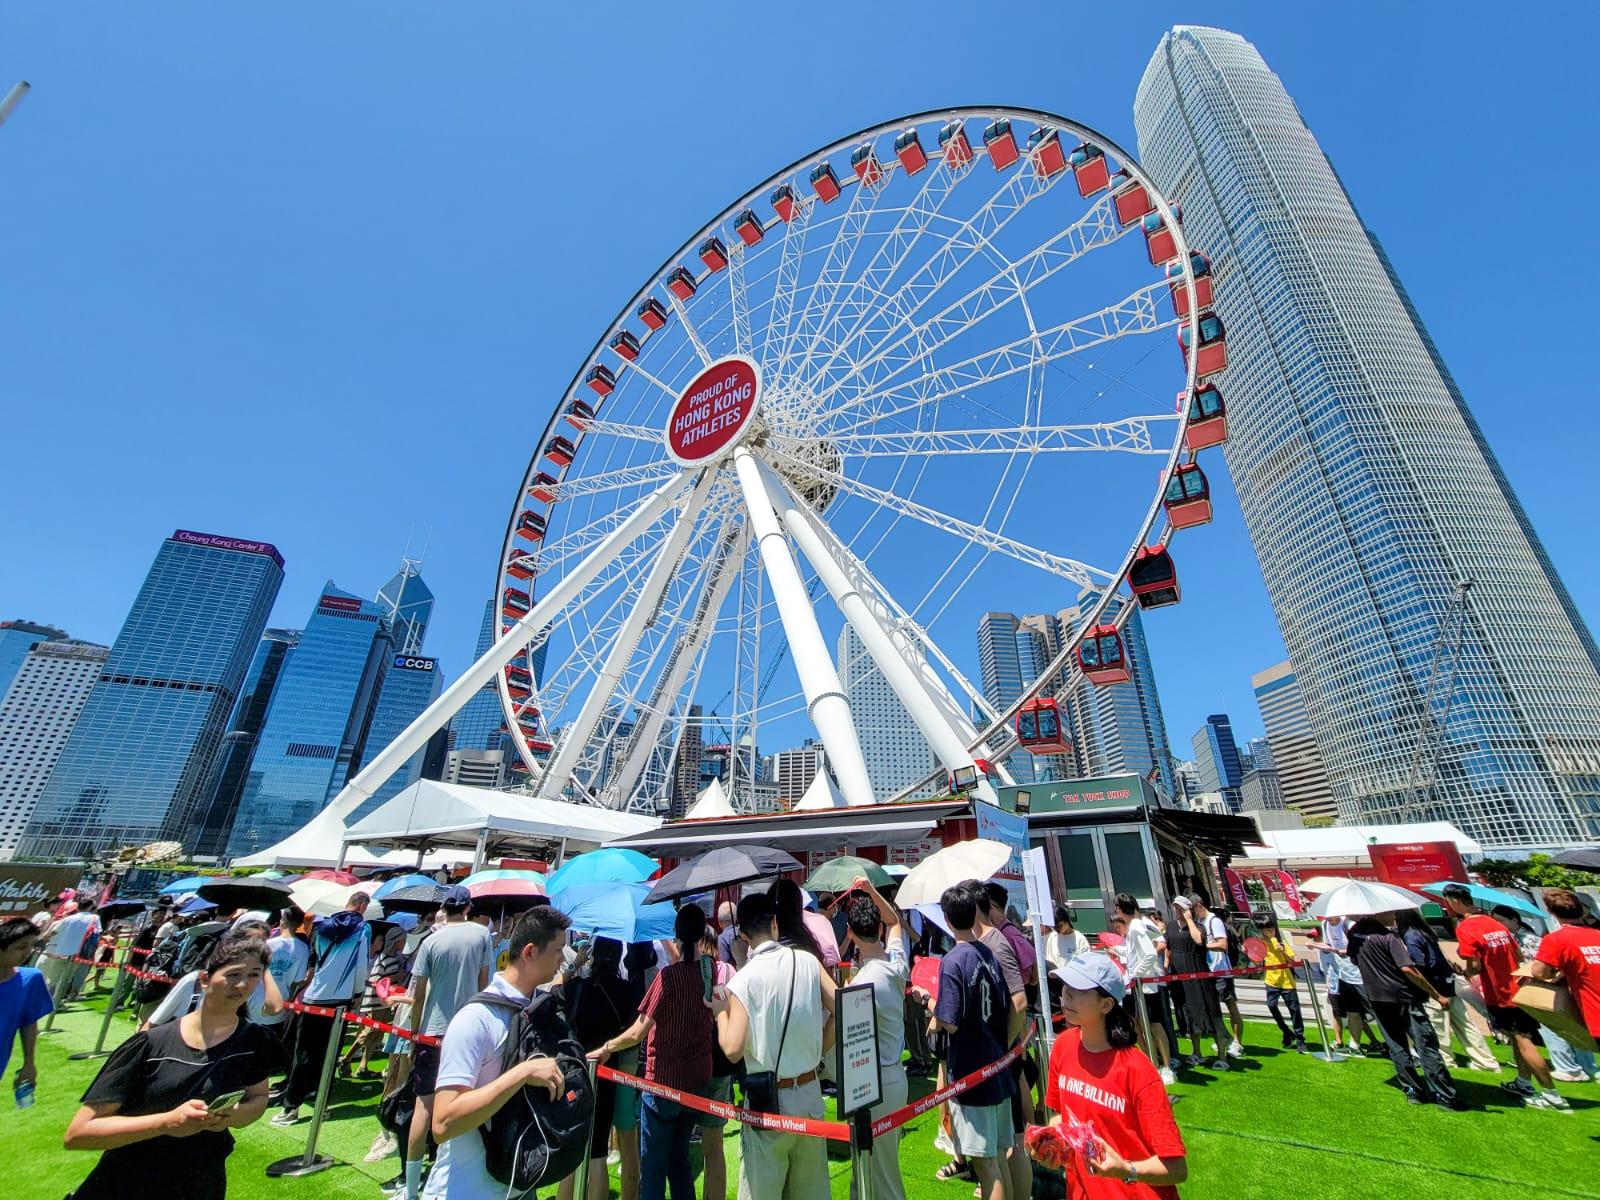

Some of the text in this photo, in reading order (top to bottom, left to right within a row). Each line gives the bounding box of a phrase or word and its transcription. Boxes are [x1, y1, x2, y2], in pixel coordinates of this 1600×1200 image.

[690, 373, 739, 408] PROUD OF
[675, 382, 751, 433] HONG KONG
[681, 406, 741, 448] ATHLETES
[179, 532, 210, 545] Cheung
[210, 537, 231, 547] Kong
[233, 541, 258, 551] Center
[405, 658, 434, 670] CCB
[0, 878, 50, 904] itality
[1232, 882, 1245, 902] AIA
[1285, 883, 1298, 901] AIA
[612, 1071, 625, 1083] Hong
[637, 1080, 665, 1096] Observation
[665, 1087, 681, 1101] Wheel
[710, 1102, 807, 1131] Hong Kong Observation Wheel
[914, 1103, 926, 1114] Hong
[877, 1116, 893, 1132] Wheel
